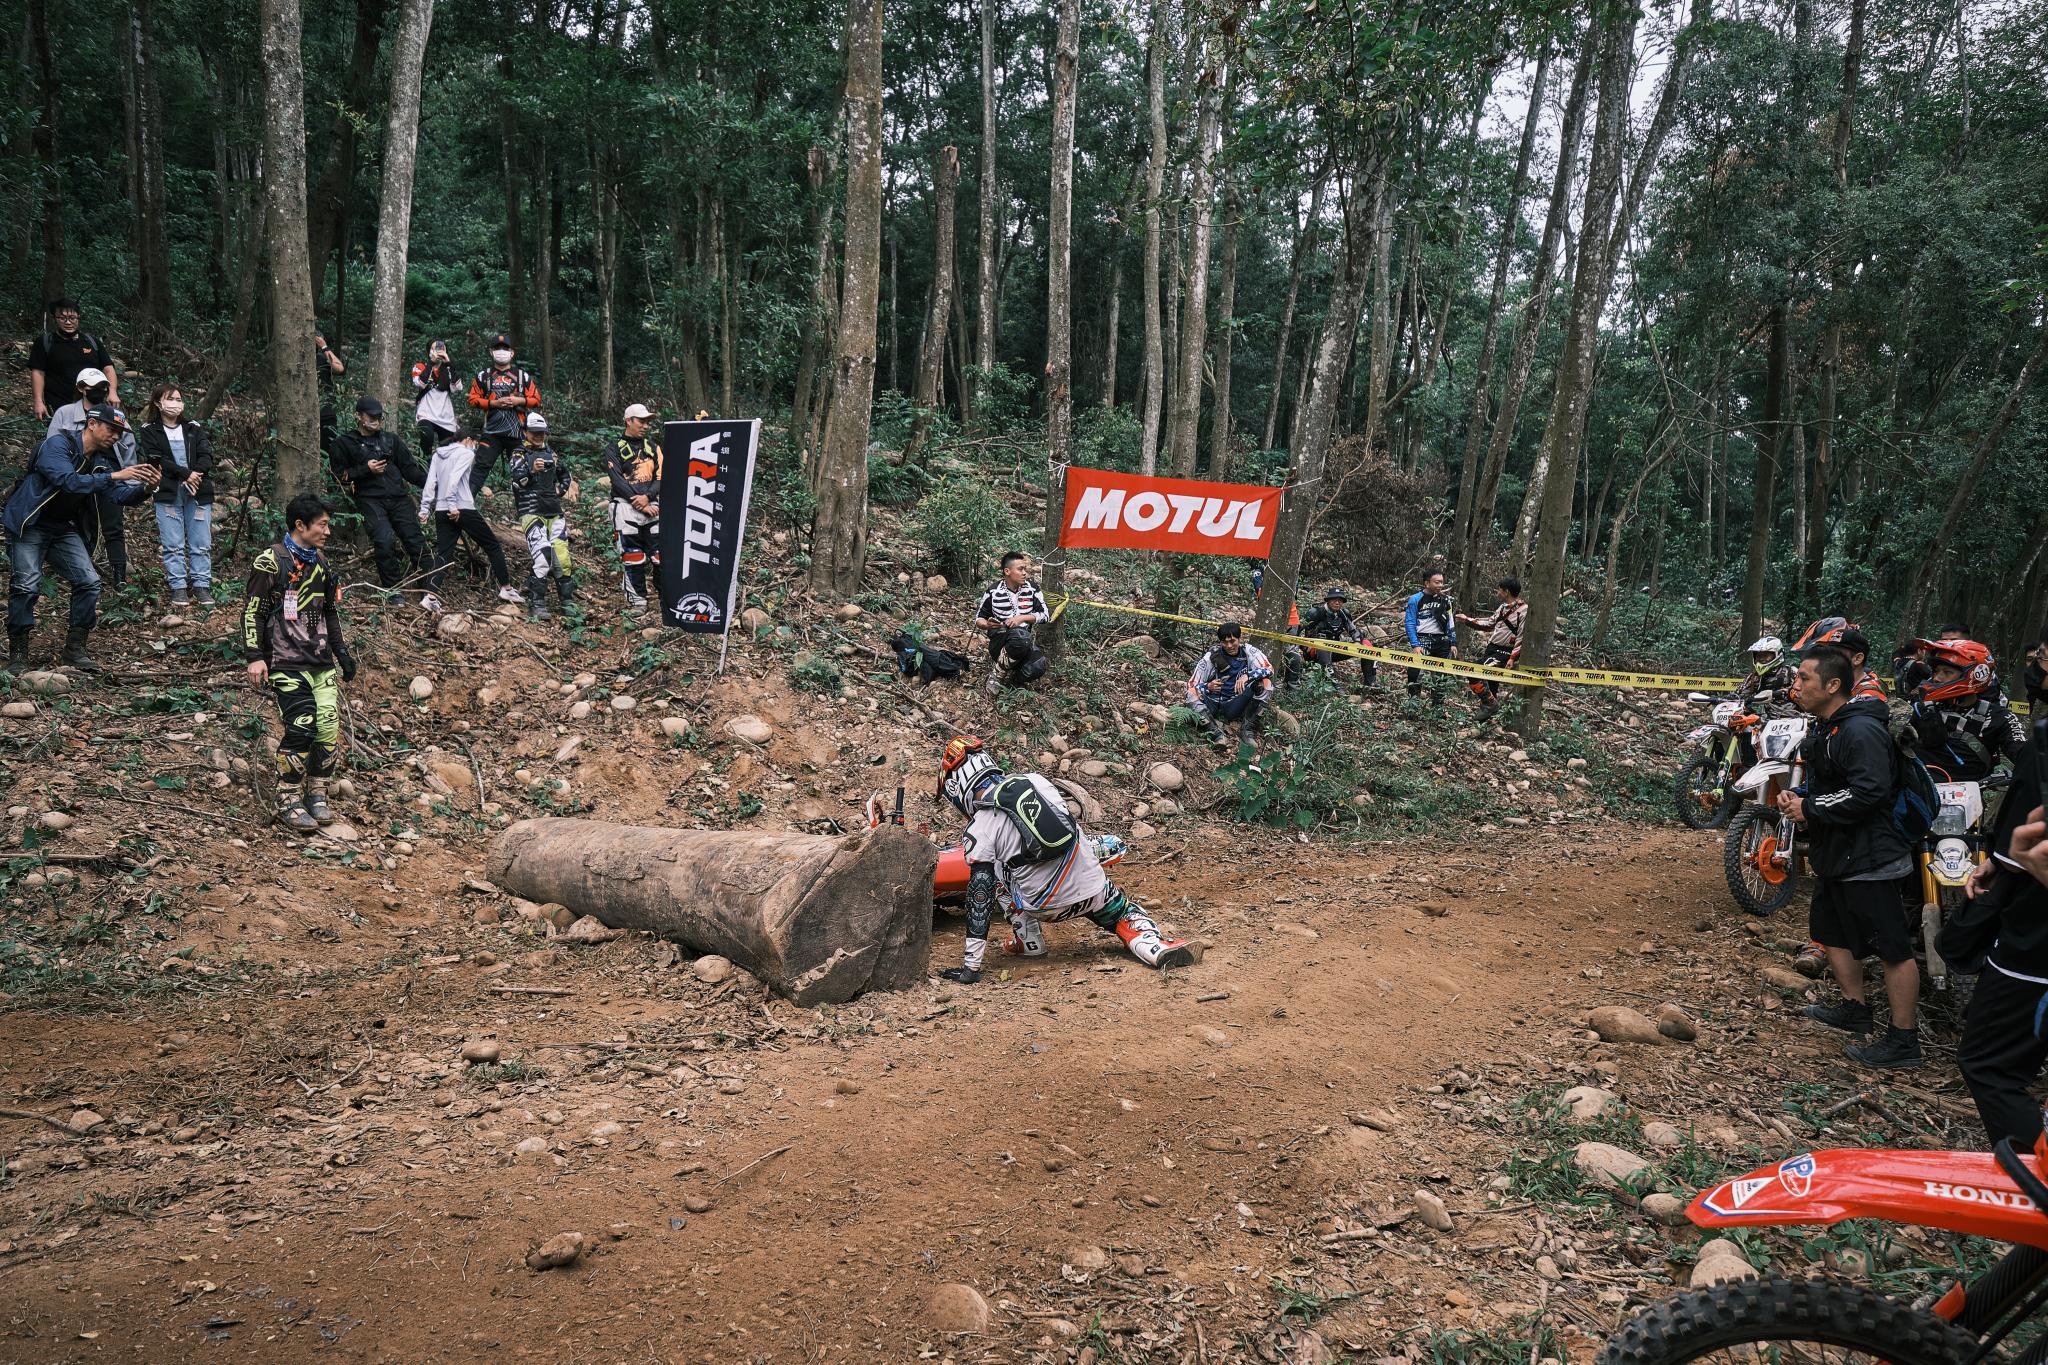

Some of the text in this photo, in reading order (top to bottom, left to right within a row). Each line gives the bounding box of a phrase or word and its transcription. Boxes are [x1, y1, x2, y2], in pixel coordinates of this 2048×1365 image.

[1070, 486, 1266, 540] MOTUL
[1389, 653, 1414, 663] TORRA
[1420, 658, 1445, 669] TORRA
[1771, 723, 1791, 732] 014
[1924, 1181, 2043, 1212] HOND
